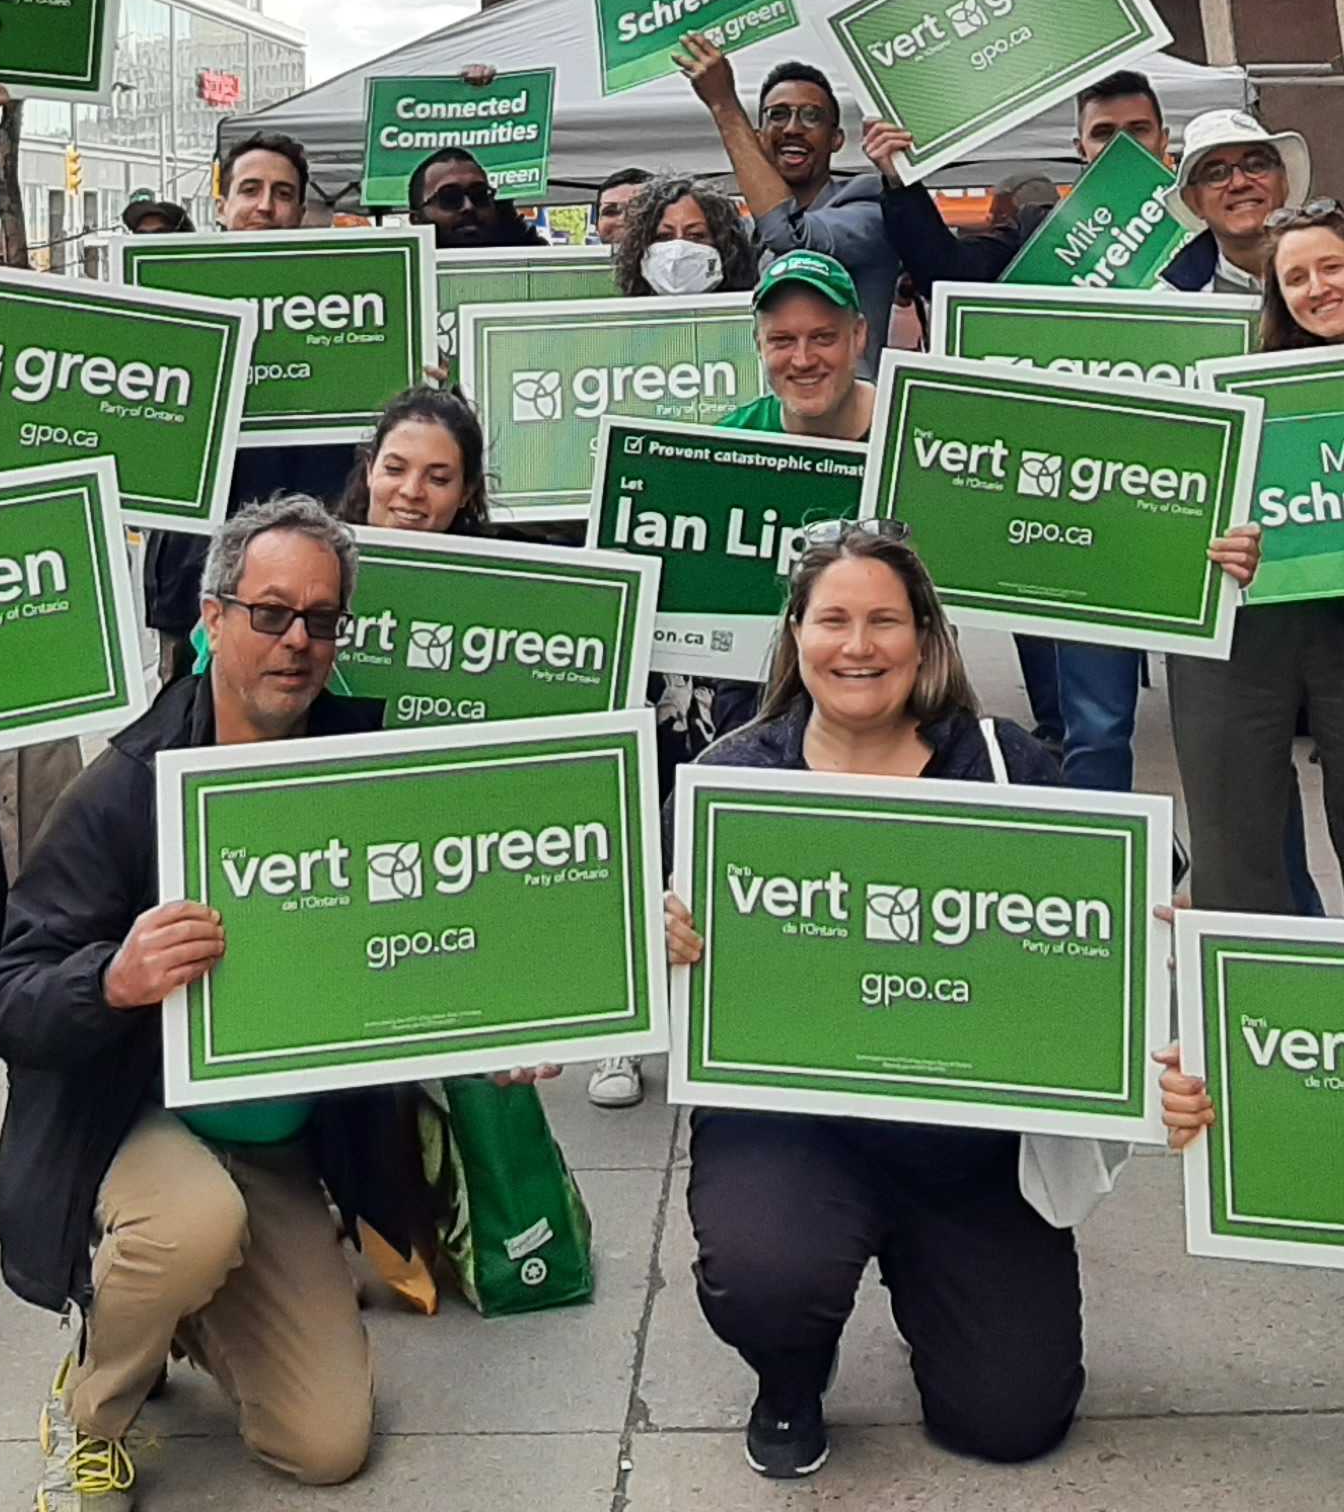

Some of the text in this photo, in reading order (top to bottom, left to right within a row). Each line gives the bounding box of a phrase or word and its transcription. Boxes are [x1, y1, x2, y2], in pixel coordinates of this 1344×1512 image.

[724, 0, 786, 40] green
[870, 13, 947, 68] vert
[970, 25, 1034, 71] gpo.ca
[395, 90, 527, 119] Connected
[379, 120, 539, 149] Communities
[487, 167, 540, 189] green
[1054, 206, 1112, 266] Mike
[1071, 184, 1167, 287] hreiner
[231, 290, 385, 332] reen
[11, 345, 191, 407] green
[571, 360, 737, 418] green
[99, 400, 185, 423] Party of Ontario
[19, 422, 99, 448] gpo.ca
[648, 440, 865, 477] Prevent catastrophic climat
[913, 436, 1208, 504] vert green
[620, 476, 644, 491] Let
[613, 495, 807, 576] Ian Lip
[1008, 517, 1094, 546] gpo.ca
[6, 608, 20, 620] of
[22, 601, 69, 617] Ontario
[461, 623, 604, 673] green
[397, 695, 486, 721] gpo.ca
[220, 847, 246, 859] Parti
[222, 820, 609, 897] vert green
[524, 868, 609, 888] Party of Ontario
[282, 900, 299, 911] de
[728, 870, 1111, 945] vert green
[782, 922, 797, 934] de
[366, 926, 476, 968] gpo.ca
[1022, 939, 1110, 957] Party of Ontario
[861, 972, 970, 1007] gpo.ca
[1241, 1015, 1267, 1028] Parti
[1304, 1076, 1321, 1089] de
